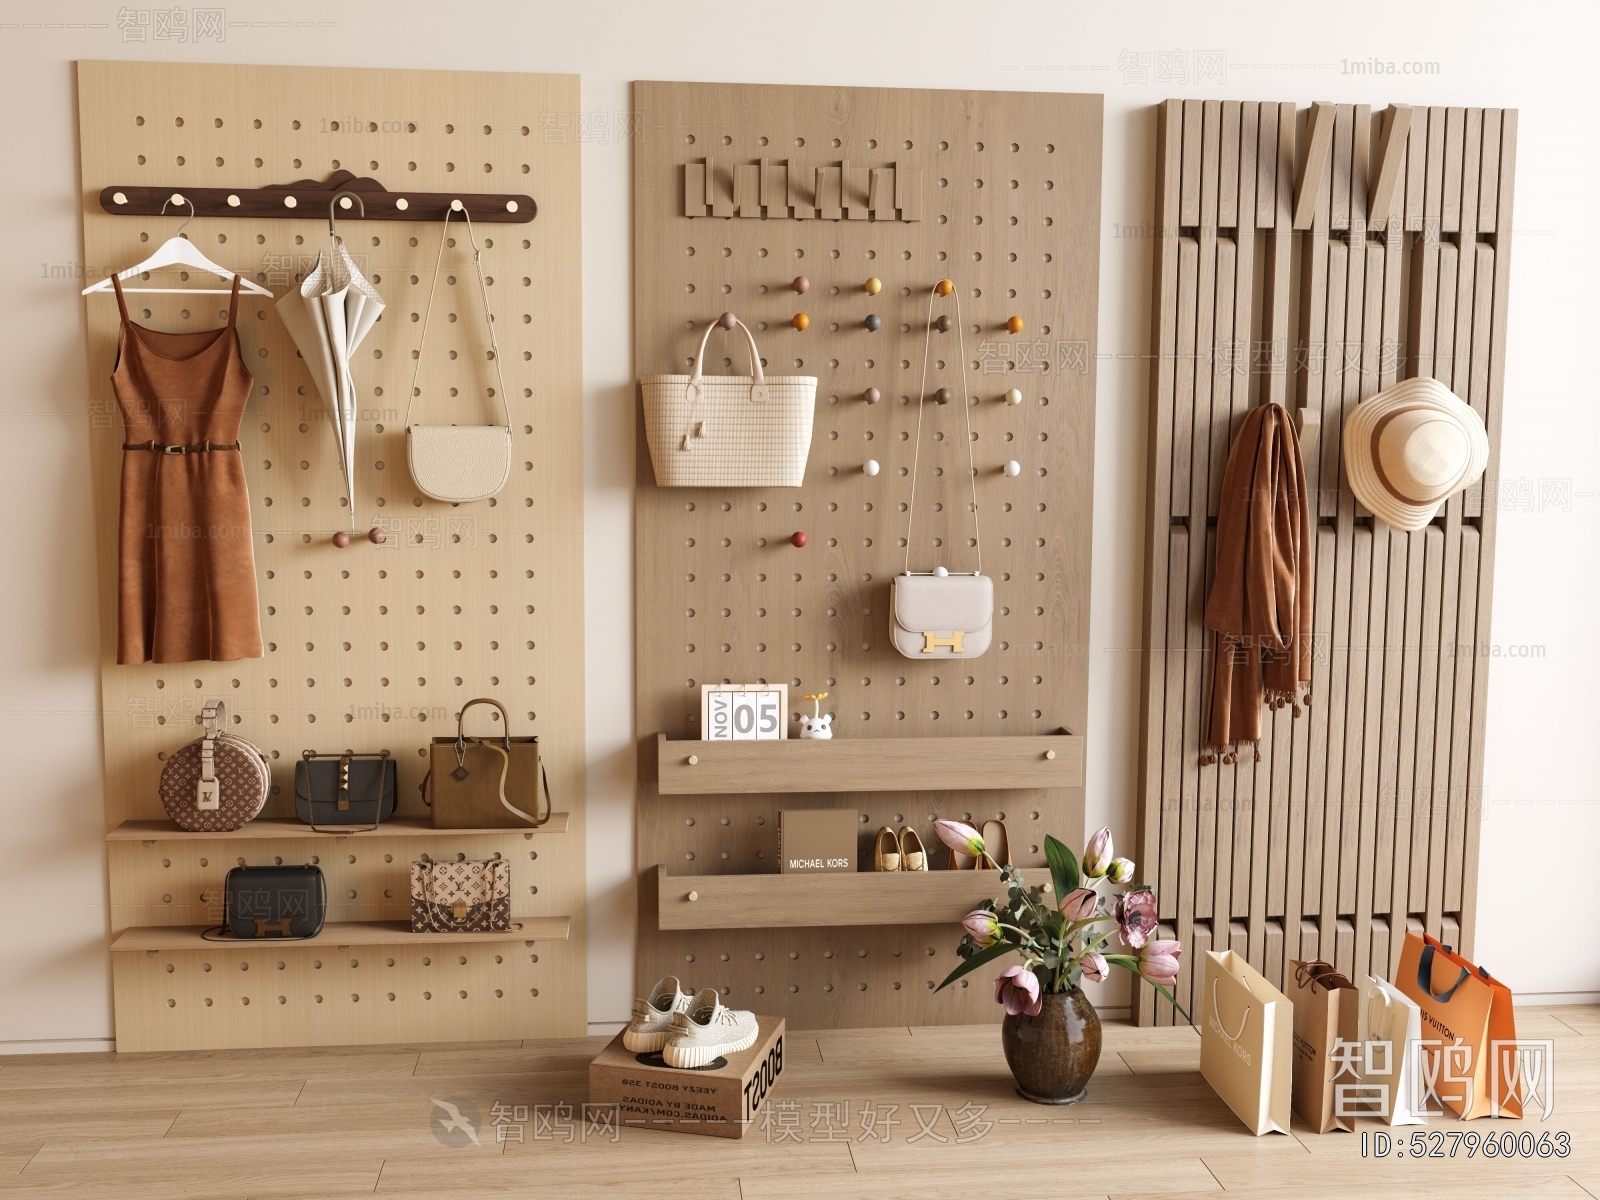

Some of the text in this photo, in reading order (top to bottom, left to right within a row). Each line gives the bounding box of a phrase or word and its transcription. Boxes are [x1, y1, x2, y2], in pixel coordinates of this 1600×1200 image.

[714, 700, 728, 738] NOV
[734, 704, 778, 734] 05
[789, 858, 849, 869] MICHAEL KORS
[1233, 1041, 1251, 1067] KORS
